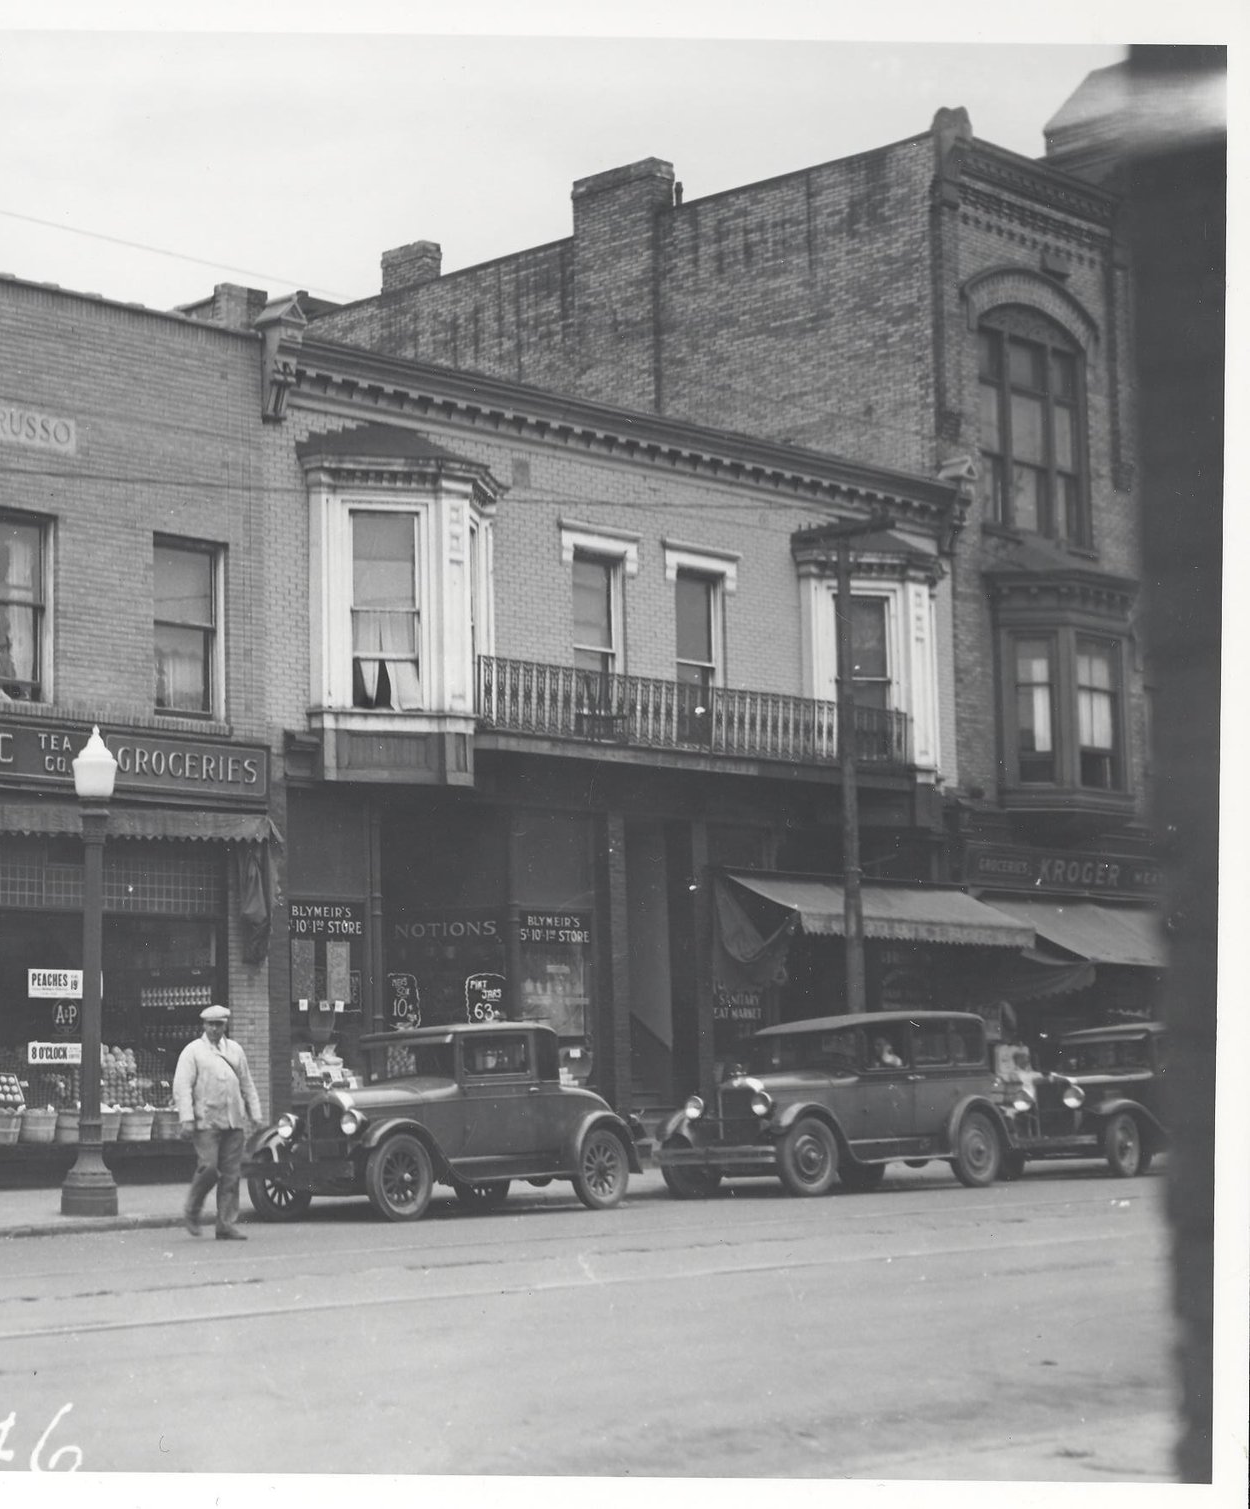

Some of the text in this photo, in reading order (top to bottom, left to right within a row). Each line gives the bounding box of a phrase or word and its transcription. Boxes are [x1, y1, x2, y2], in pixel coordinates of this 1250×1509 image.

[39, 733, 72, 751] TEA
[117, 745, 257, 784] GROCERIES
[1040, 857, 1120, 886] KROGER
[291, 905, 351, 918] BLYMEIR'S
[327, 920, 362, 935] STORE
[527, 915, 581, 928] BLYMEIR'S
[394, 921, 497, 938] NOTIONS
[558, 930, 590, 943] STORE
[31, 973, 68, 987] PEACHES
[55, 1004, 77, 1024] A&P
[31, 1046, 37, 1060] 8
[38, 1046, 68, 1060] O'CLOCK
